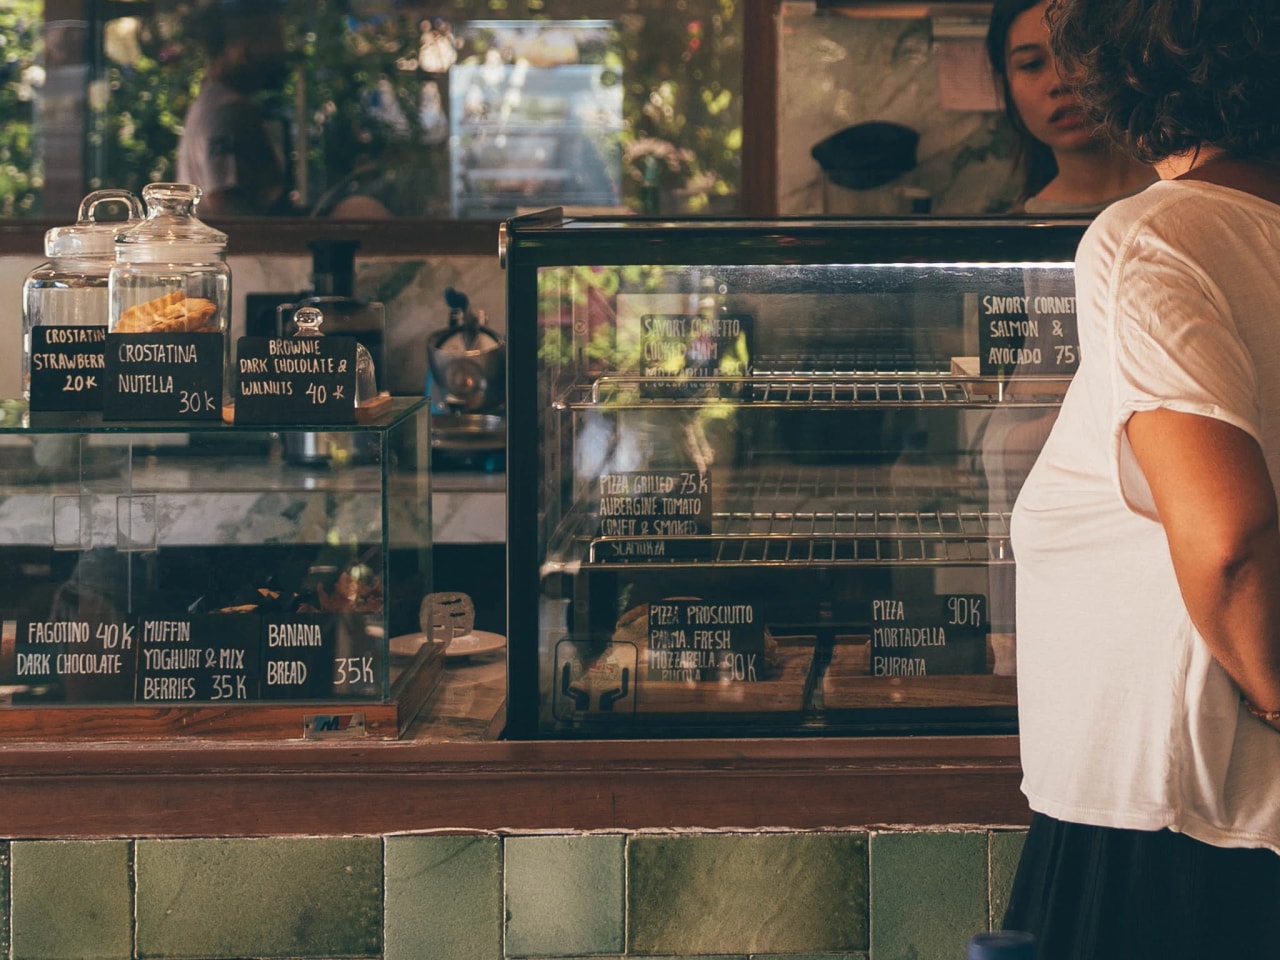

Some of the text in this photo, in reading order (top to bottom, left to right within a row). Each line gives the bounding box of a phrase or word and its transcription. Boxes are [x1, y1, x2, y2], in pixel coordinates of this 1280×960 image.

[982, 295, 1078, 315] SAVORY CORNET
[46, 329, 106, 344] CROSTATIN
[644, 318, 686, 339] SAVORY
[990, 319, 1064, 338] SALMON &
[118, 343, 198, 363] CROSTATINA
[268, 338, 321, 356] BROWNIE
[988, 345, 1081, 365] AVOCADO 75
[33, 353, 106, 371] STRAWBERR
[240, 357, 348, 374] DARK CHOCOLATE &
[62, 374, 98, 391] 20K
[118, 373, 174, 394] NUTELLA
[241, 380, 294, 396] WALNUTS
[600, 474, 630, 495] PIZZA
[634, 474, 674, 494] GRILLED
[653, 519, 698, 536] SMOKED
[650, 604, 754, 626] PIZZA PROSCIUTTO
[873, 596, 981, 628] PIZZA 90K
[28, 621, 135, 650] FAGOTINO 40K
[143, 620, 191, 642] MUFFIN
[268, 623, 322, 647] BANANA
[694, 629, 731, 649] FRESH
[874, 627, 946, 648] MORTADELLA
[17, 653, 123, 676] DARK CHOCOLATE
[143, 647, 245, 671] YOGHURT & MIX
[874, 655, 927, 677] BURRATA
[267, 656, 374, 685] BREAD 35K
[143, 675, 248, 701] BERRIES 35K
